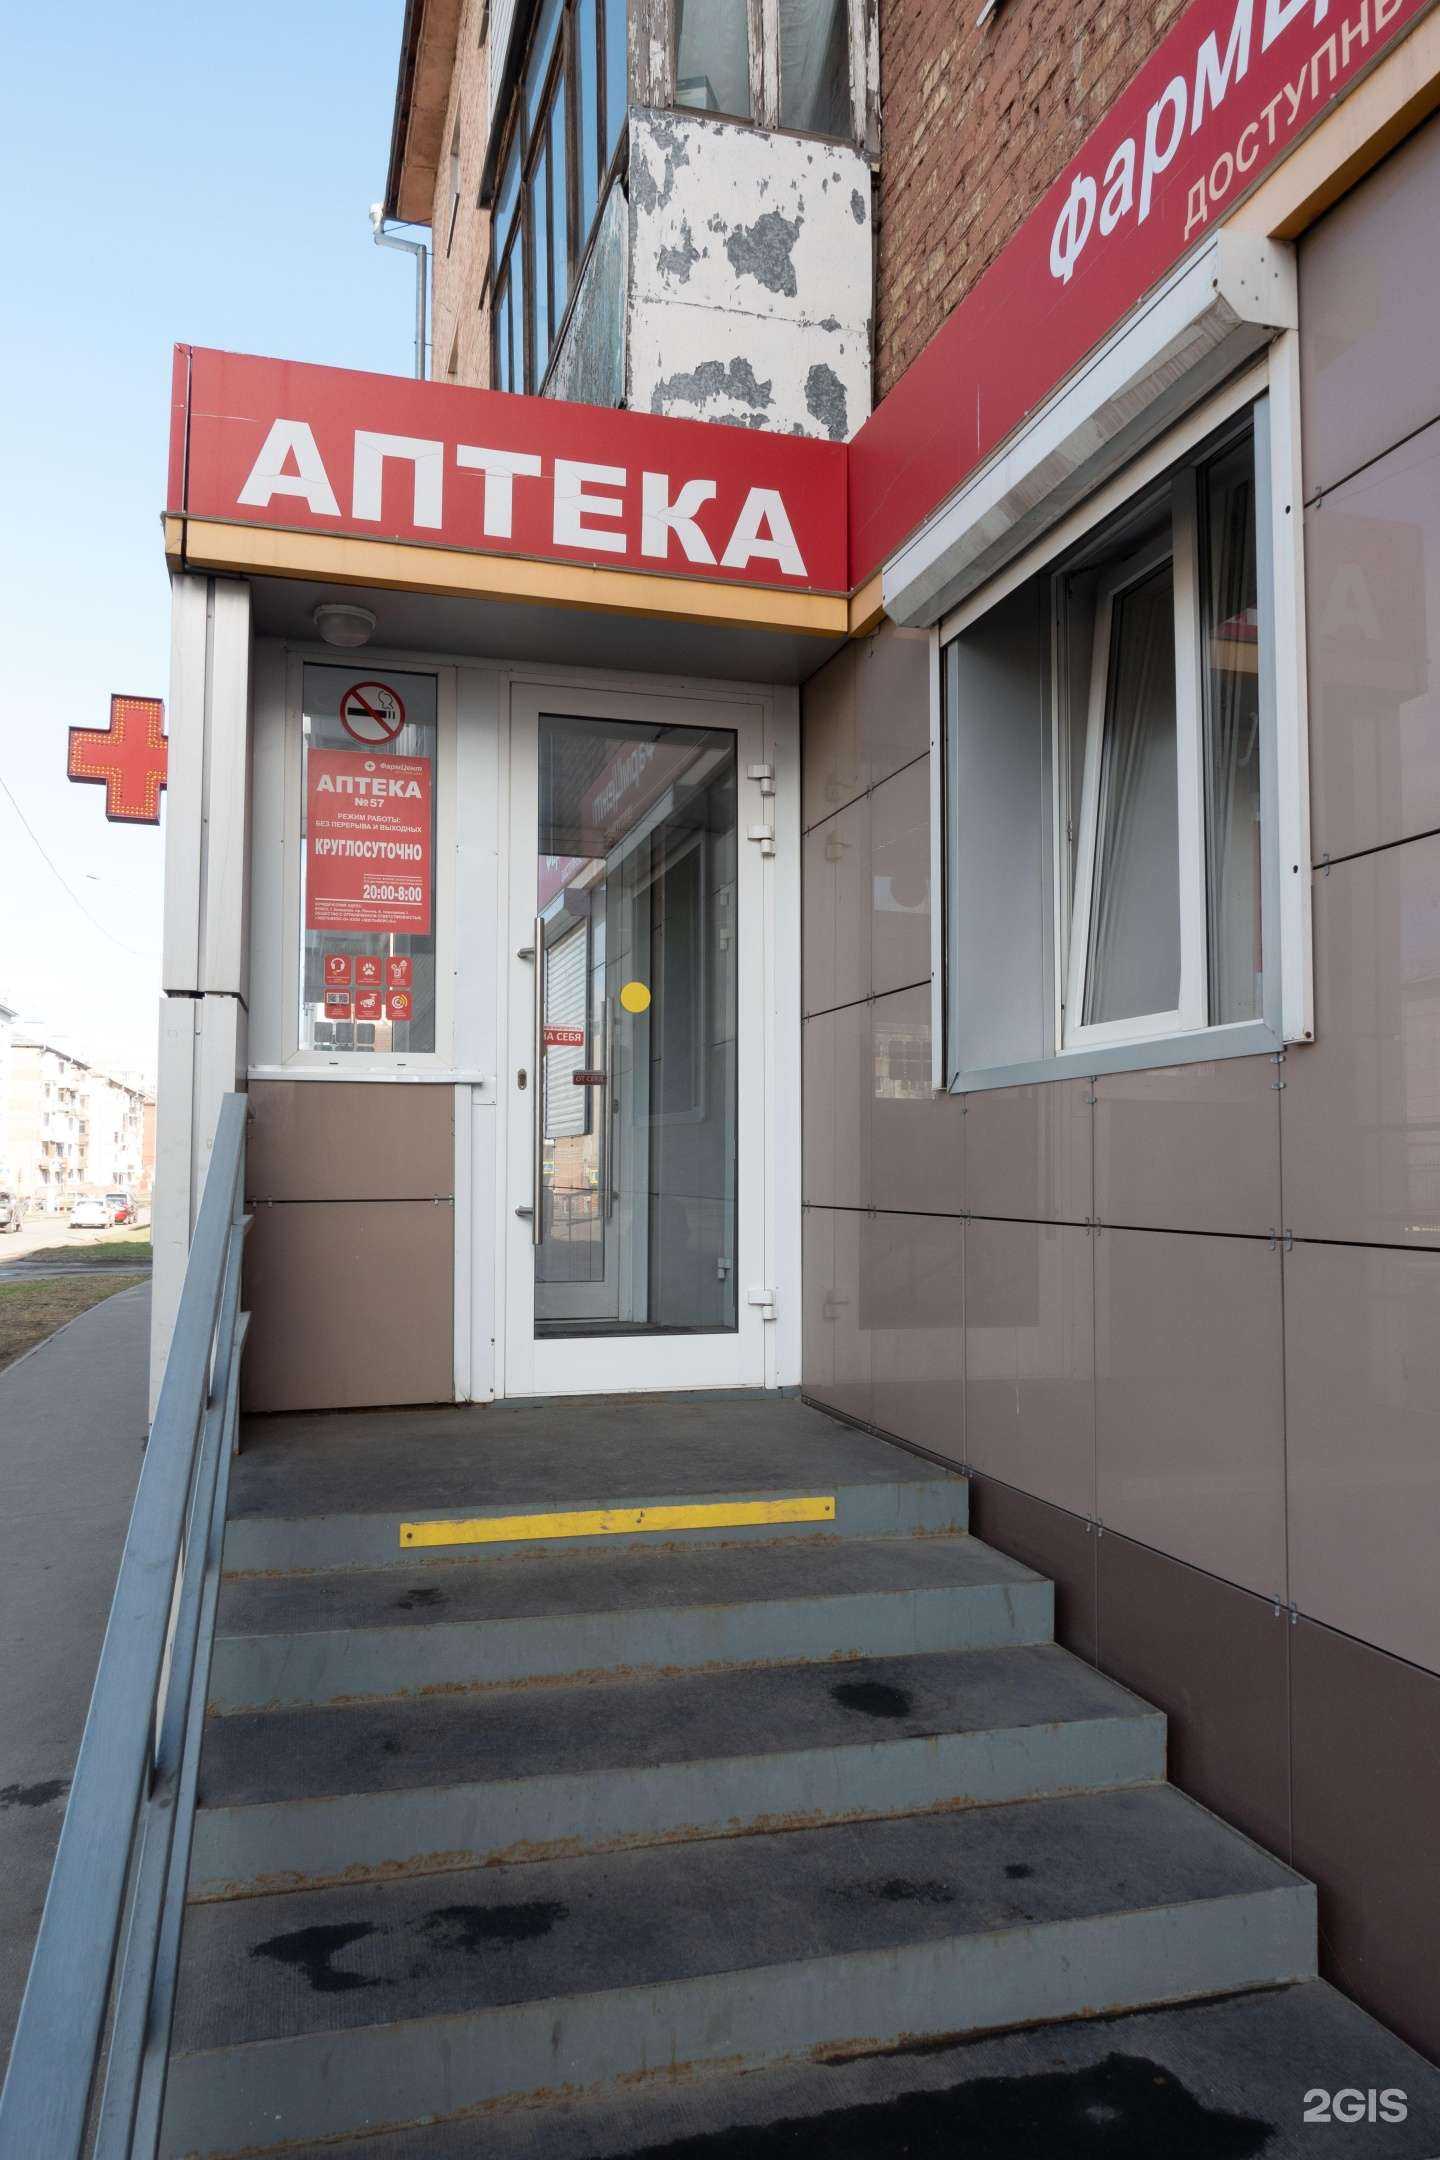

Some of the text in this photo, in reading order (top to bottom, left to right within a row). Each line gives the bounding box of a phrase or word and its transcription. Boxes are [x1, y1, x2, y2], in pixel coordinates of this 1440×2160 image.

[236, 417, 809, 578] АПТЕКА
[316, 774, 422, 798] АПТЕКА
[337, 812, 401, 823] РЕЖИМ РАБОТЫ:
[331, 821, 371, 830] ПЕРЕРЫВА
[379, 825, 422, 833] ВЫХОДНЫХ
[315, 838, 422, 861] КРУГЛОСУТОЧНО
[363, 884, 422, 902] 20:00-8:00
[556, 1032, 582, 1042] СЕБЯ
